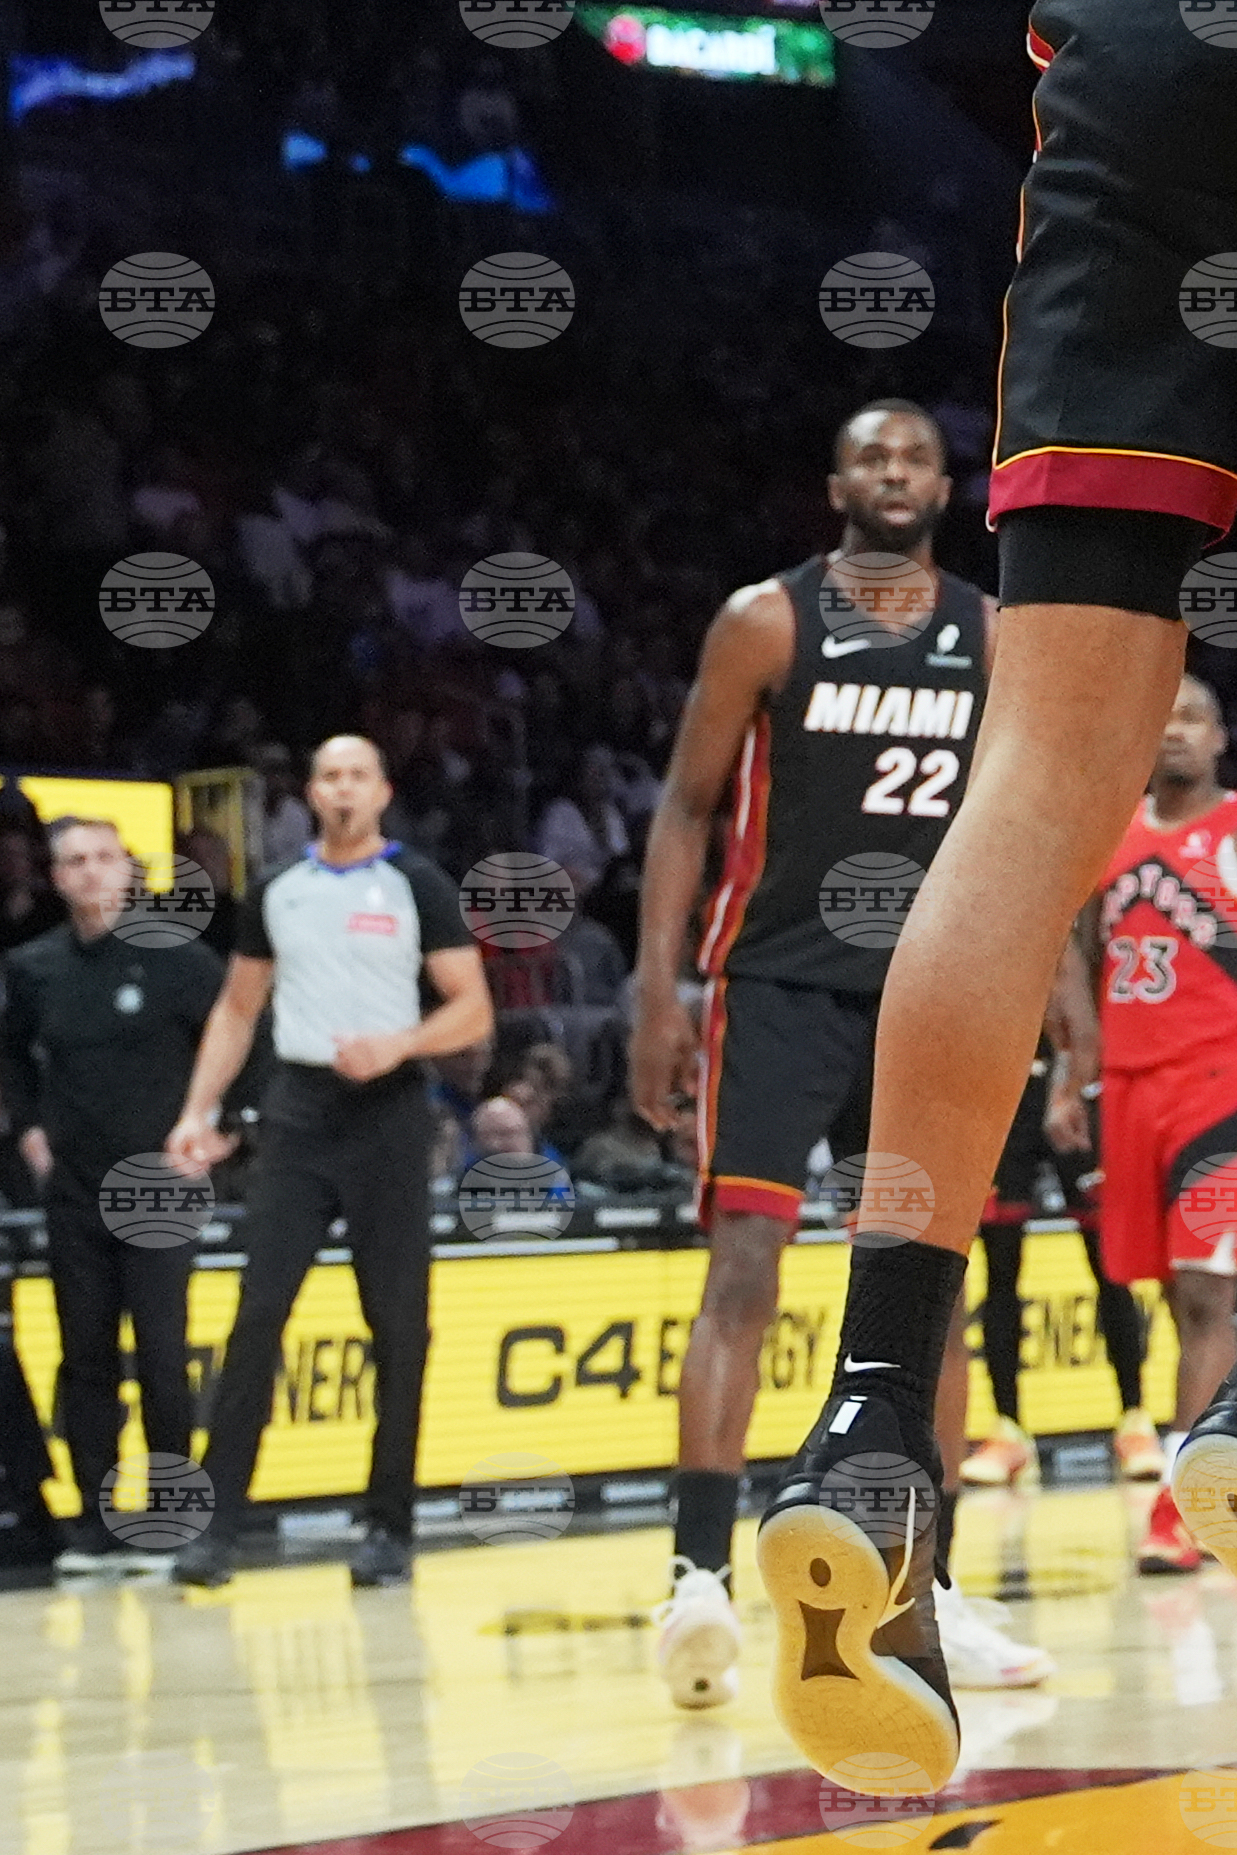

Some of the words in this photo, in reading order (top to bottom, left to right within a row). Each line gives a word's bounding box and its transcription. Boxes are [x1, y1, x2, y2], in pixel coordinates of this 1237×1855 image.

[804, 682, 974, 740] MIAMI
[862, 746, 960, 818] 22
[1107, 934, 1179, 1004] 23
[495, 1318, 641, 1409] C4
